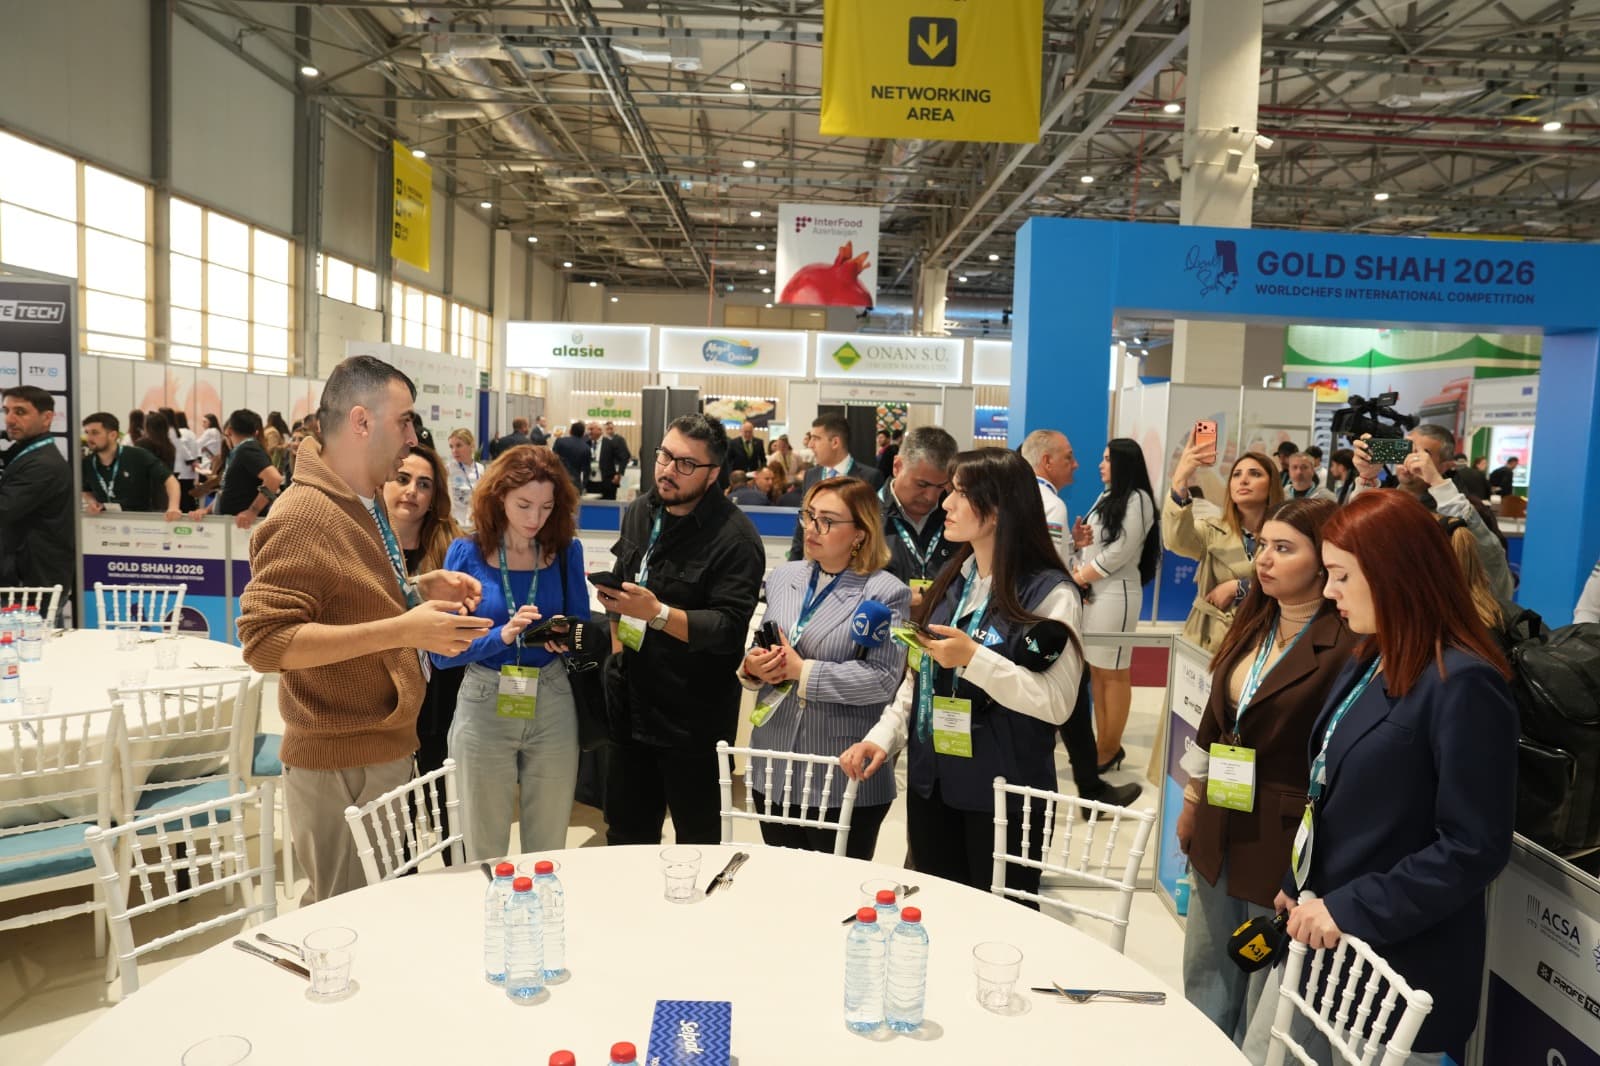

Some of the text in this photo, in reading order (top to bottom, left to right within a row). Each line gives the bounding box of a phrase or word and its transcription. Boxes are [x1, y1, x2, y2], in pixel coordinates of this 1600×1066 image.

[871, 85, 991, 103] NETWORKING
[907, 107, 955, 121] AREA
[814, 217, 863, 227] InterFood
[1257, 250, 1345, 278] GOLD
[1354, 255, 1446, 282] SHAH
[1454, 259, 1535, 285] 2026
[1255, 284, 1535, 305] WORLDCHEFS INTERNATIONAL COMPETITION
[552, 344, 605, 357] alasia
[866, 346, 916, 361] ONAN
[587, 407, 632, 418] alasia
[108, 562, 204, 575] GOLD SHAH 2026
[1541, 907, 1581, 945] ACSA
[677, 1019, 705, 1055] Selpak
